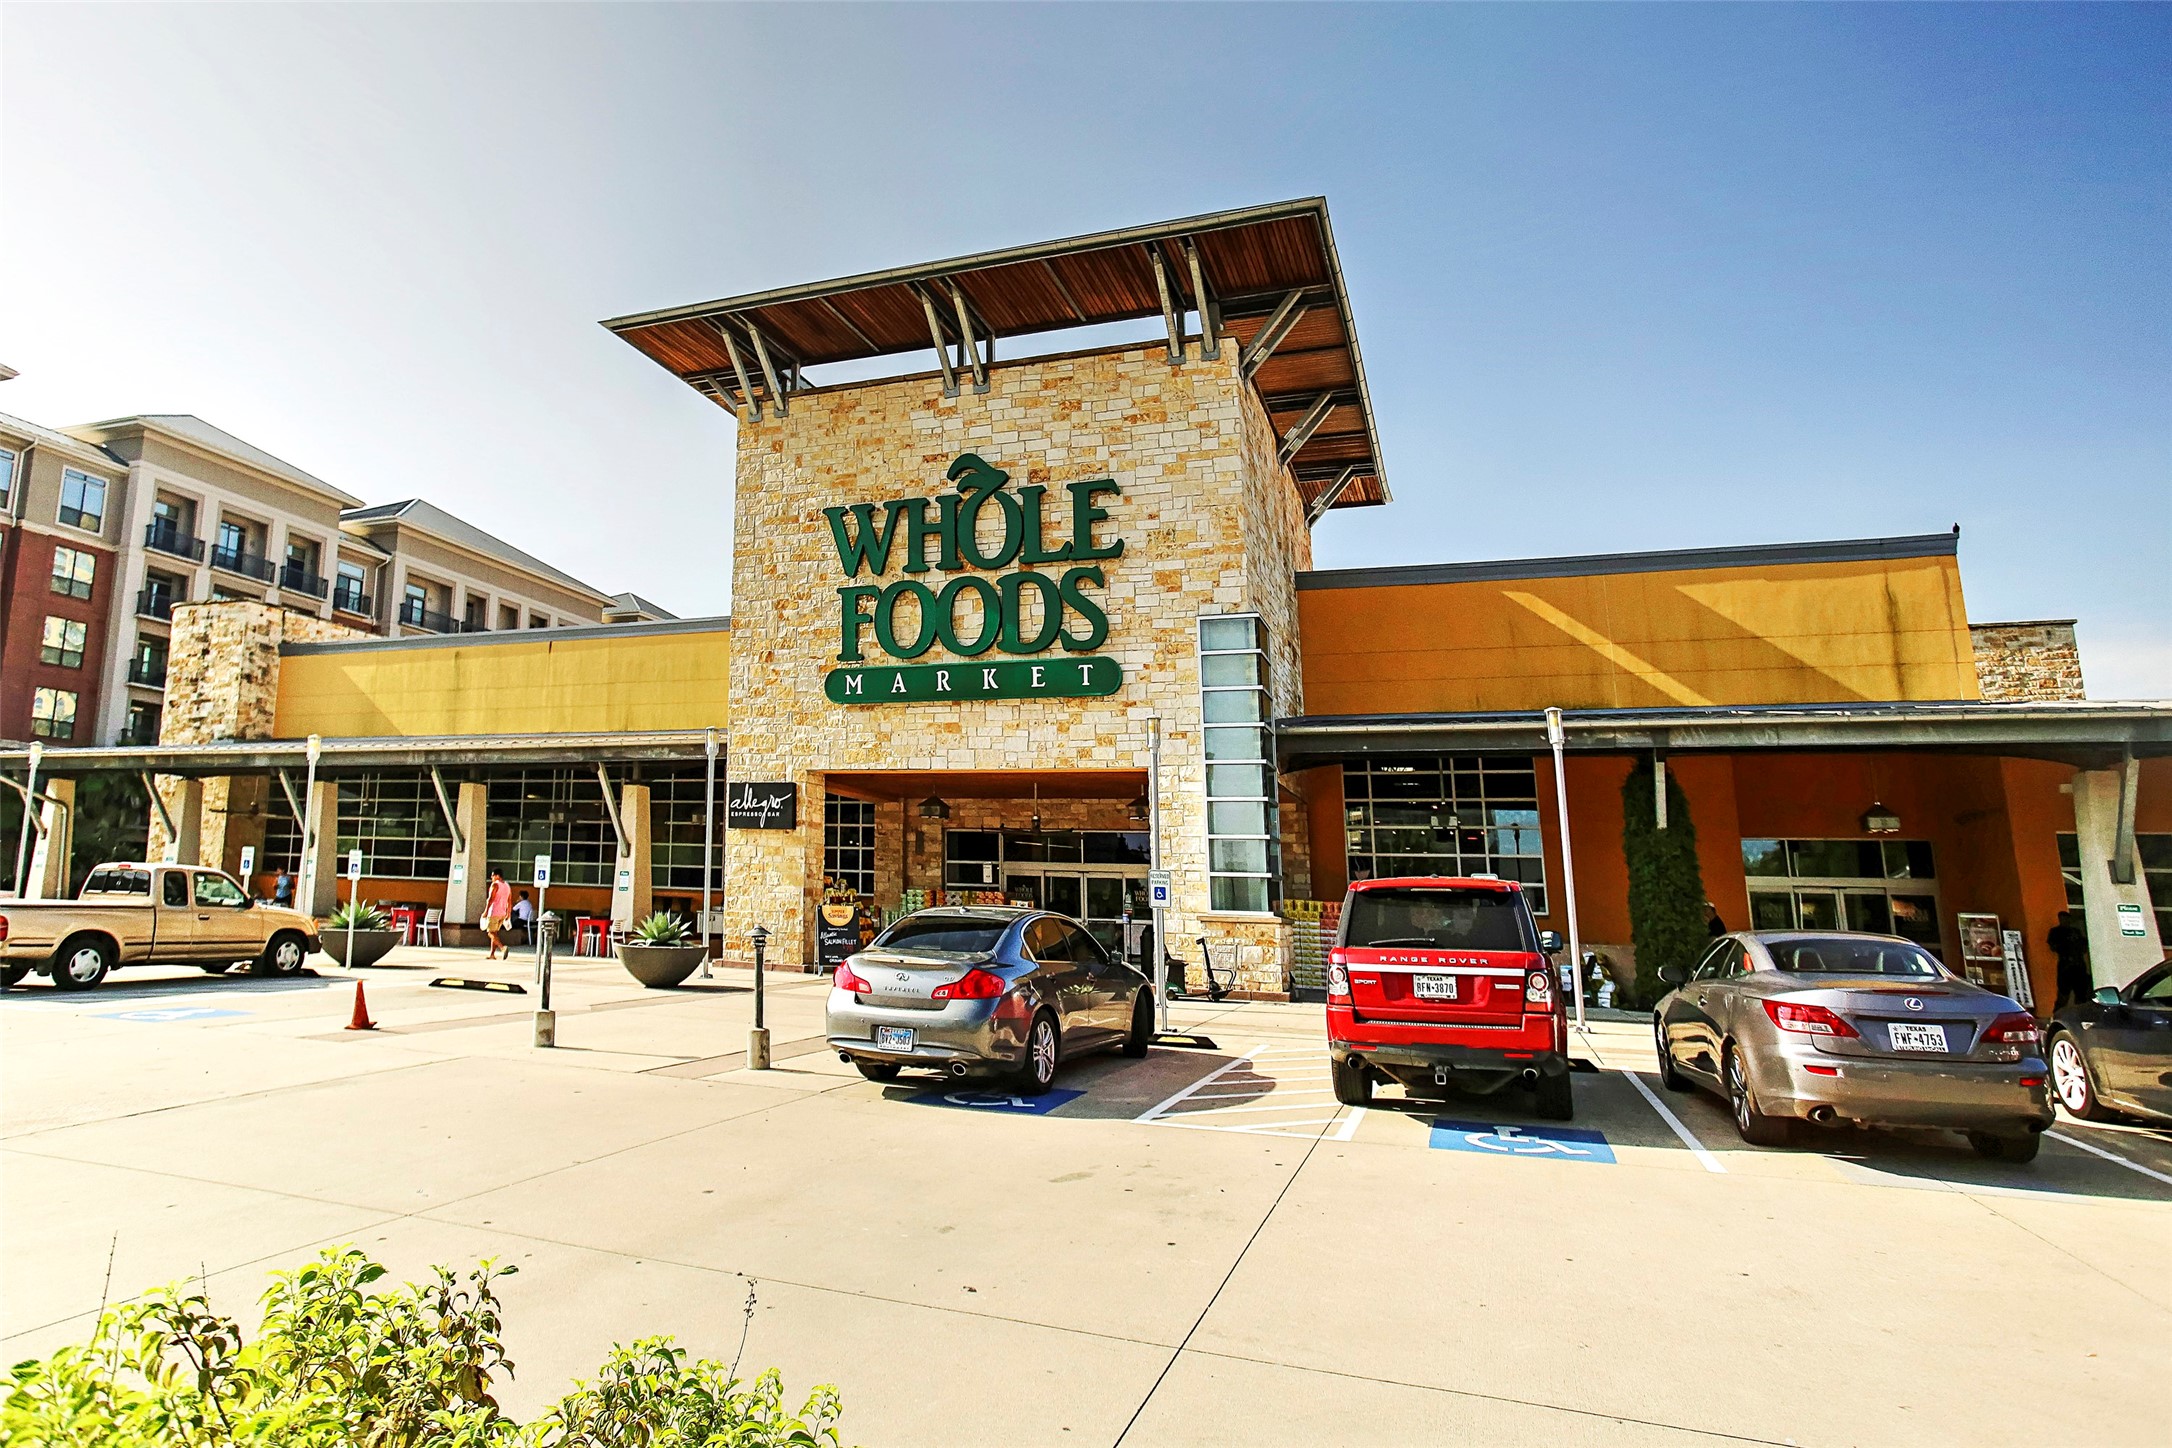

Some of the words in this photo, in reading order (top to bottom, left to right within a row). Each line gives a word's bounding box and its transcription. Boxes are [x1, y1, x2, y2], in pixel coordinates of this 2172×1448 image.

[822, 453, 1125, 578] WHOLE
[836, 565, 1110, 663] FOODS
[844, 664, 1095, 696] MARKET
[1379, 955, 1429, 963] RANGE
